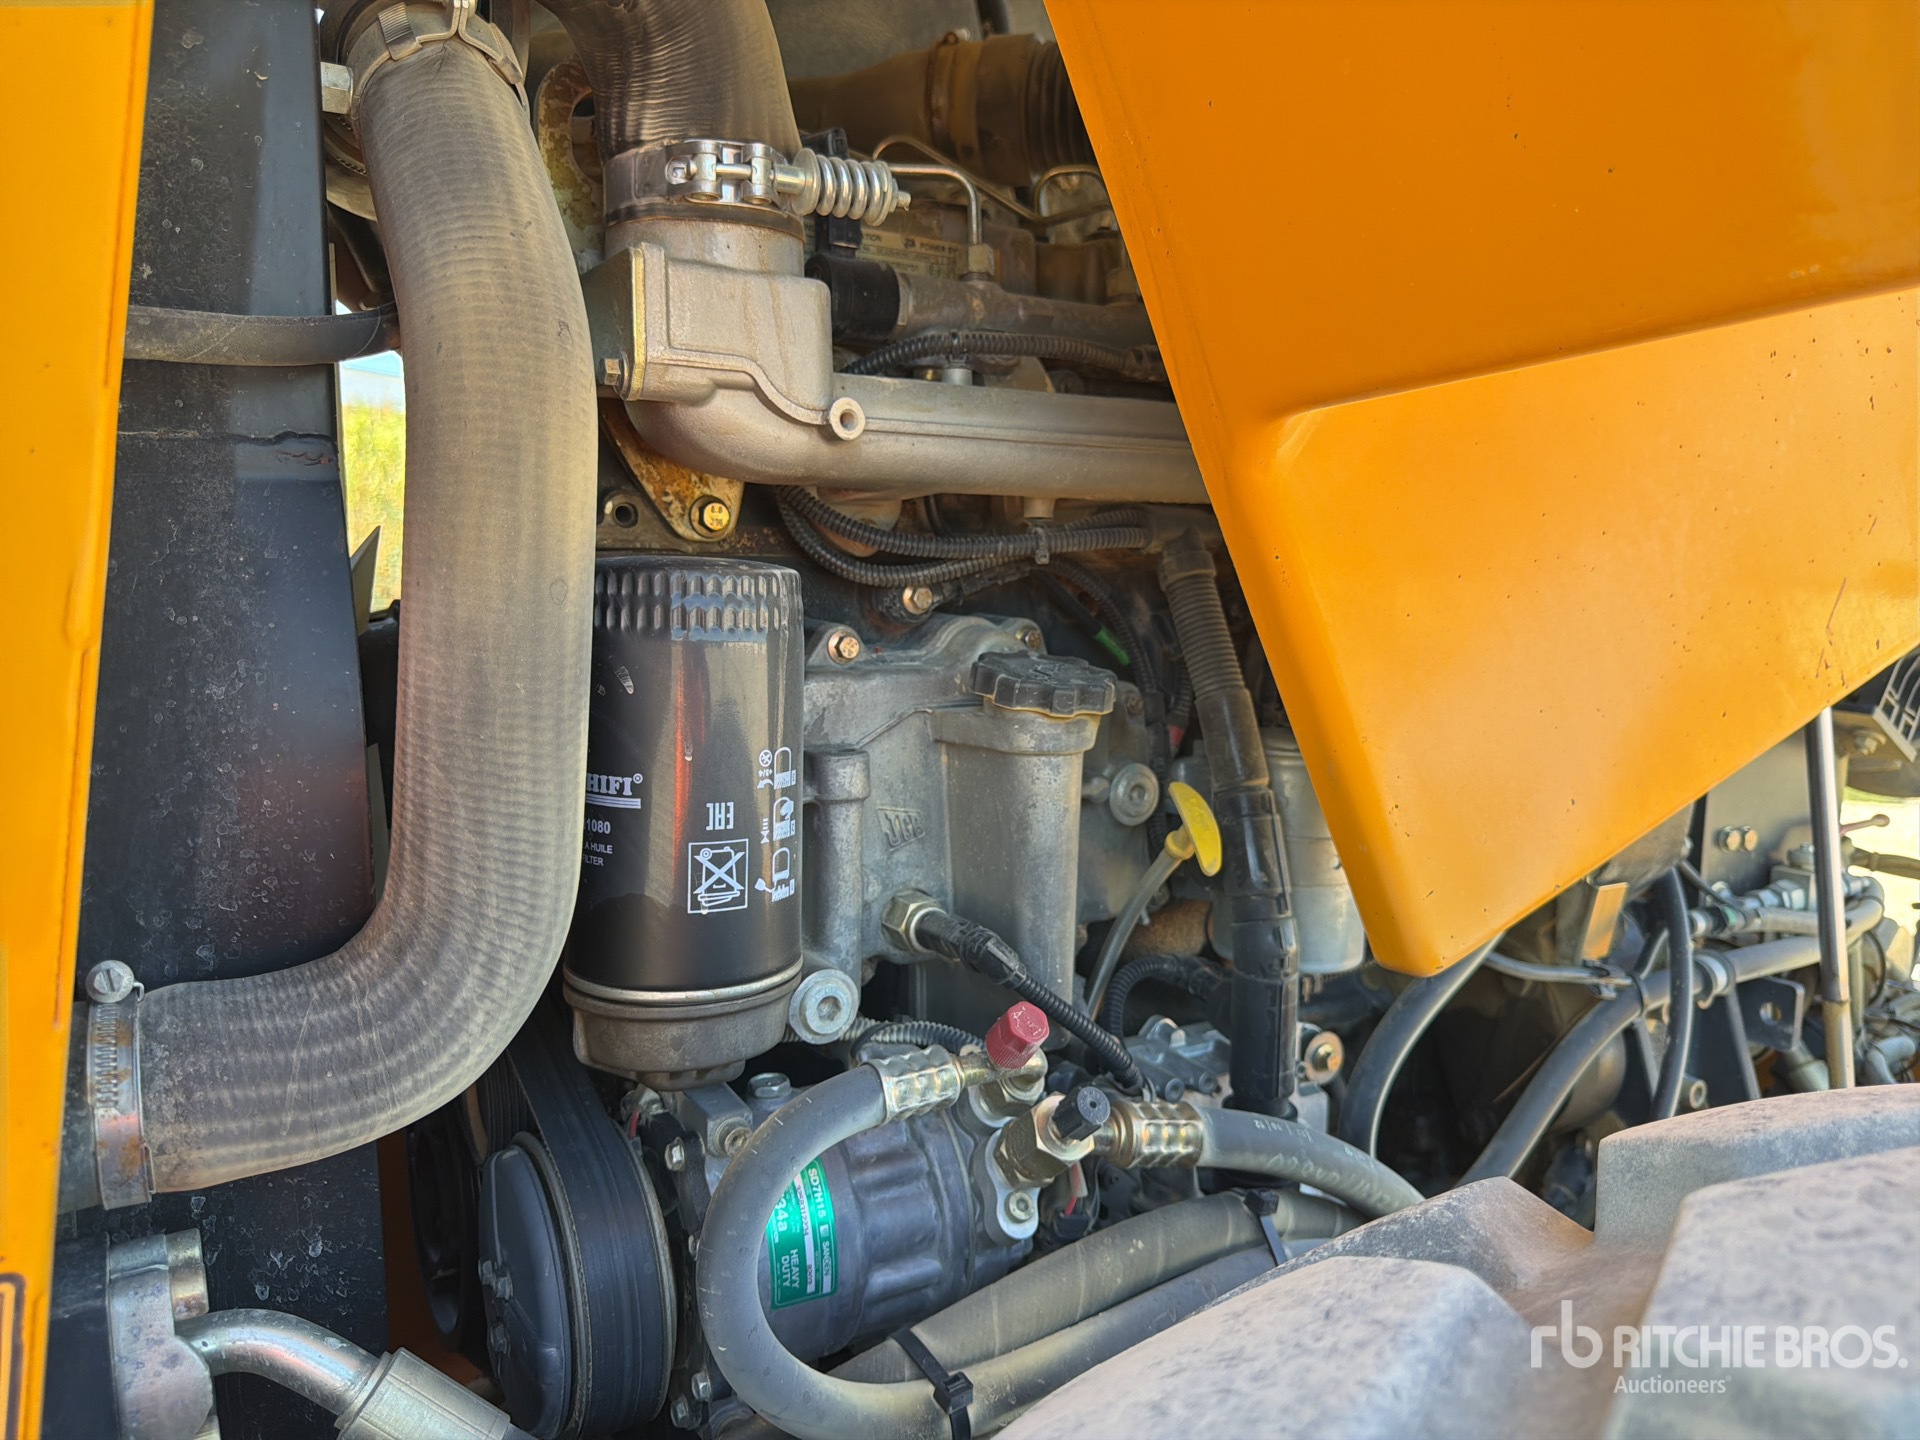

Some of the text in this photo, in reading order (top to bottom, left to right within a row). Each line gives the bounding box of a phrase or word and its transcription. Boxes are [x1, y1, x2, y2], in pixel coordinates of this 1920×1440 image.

[590, 841, 613, 855] HUILE
[775, 1192, 789, 1232] 34a
[781, 1255, 791, 1287] DUTY
[790, 1248, 800, 1289] HEAVY
[822, 1240, 832, 1277] SANDEN
